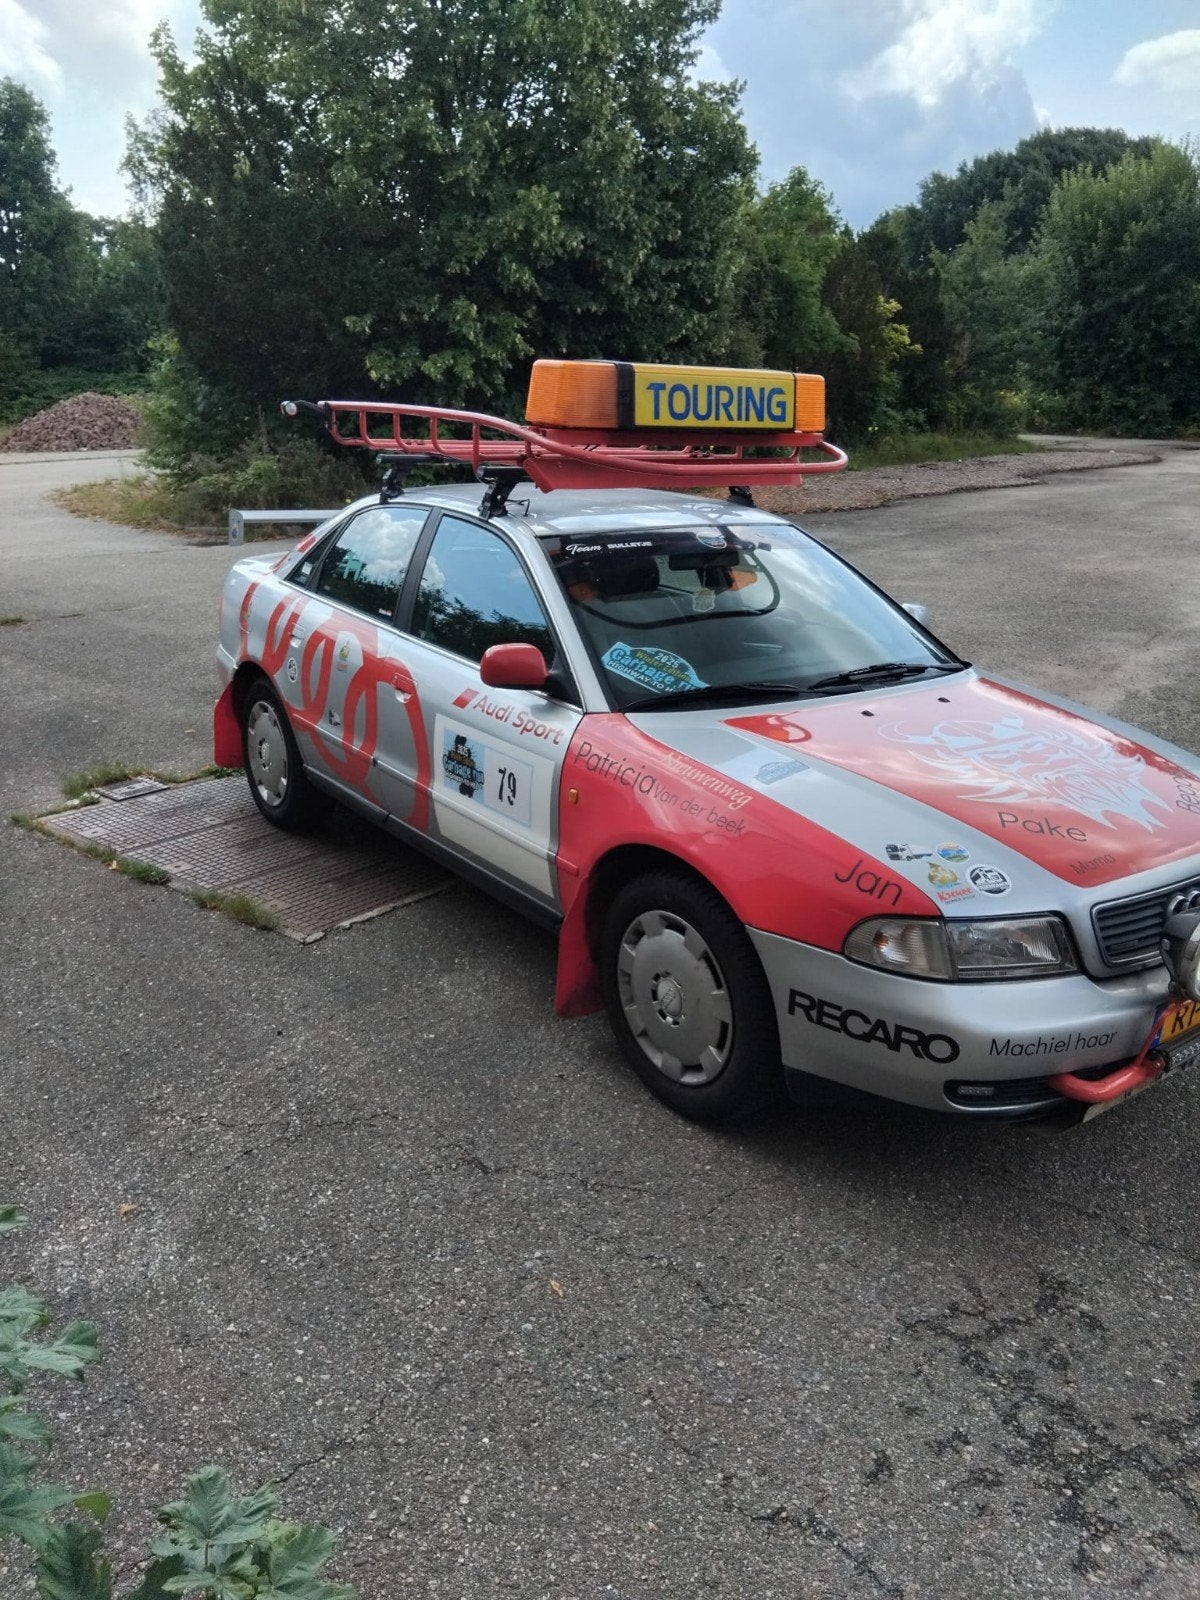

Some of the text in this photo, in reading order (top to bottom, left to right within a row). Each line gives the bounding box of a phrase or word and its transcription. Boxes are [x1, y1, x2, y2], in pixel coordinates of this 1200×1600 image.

[646, 382, 786, 422] TOURING
[565, 543, 602, 555] Team
[607, 660, 652, 682] HIGHWAY
[651, 680, 664, 689] TO
[655, 652, 680, 669] 2025
[473, 695, 564, 745] Audi Sport
[498, 767, 517, 806] 79
[573, 741, 656, 795] Patricia
[680, 797, 707, 816] der
[706, 806, 746, 834] beek
[998, 811, 1088, 842] Pake
[1070, 853, 1117, 875] Mama
[834, 859, 903, 907] Jan
[787, 987, 960, 1064] RECARO
[989, 1031, 1118, 1056] Machiel haar
